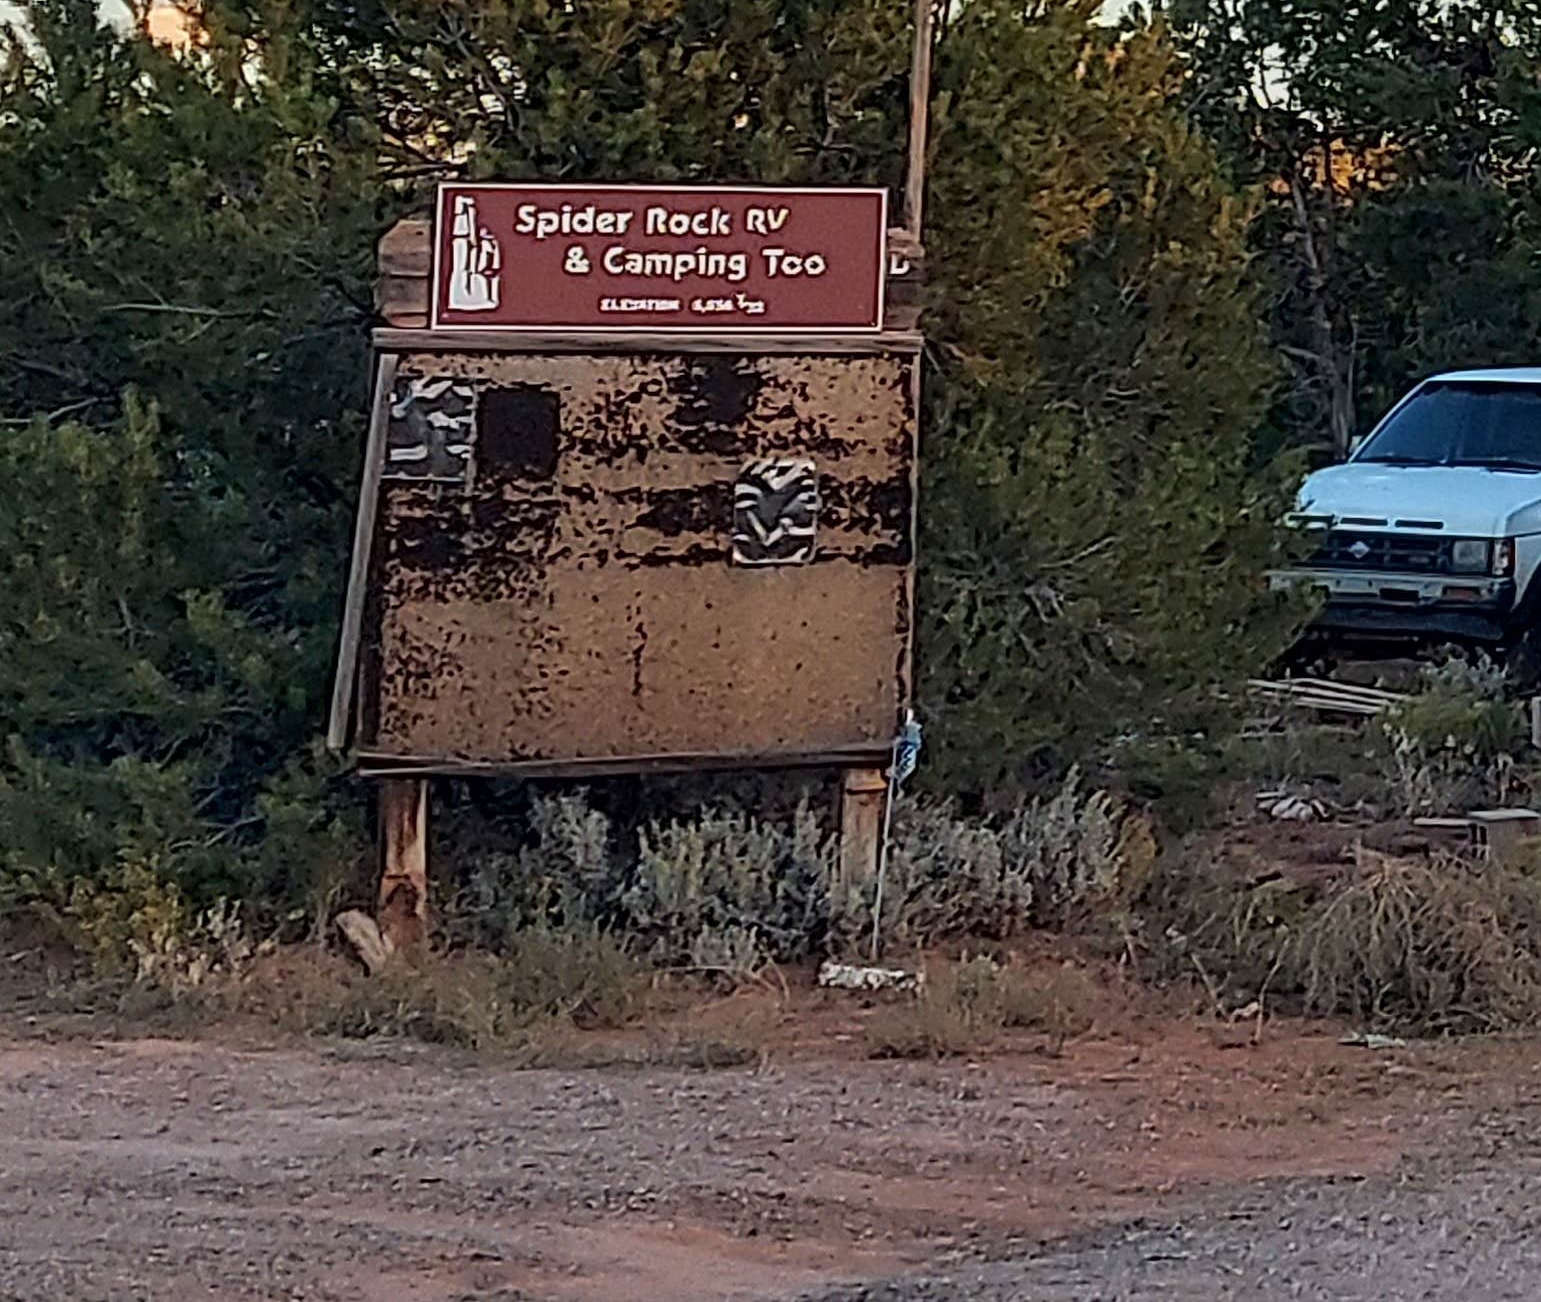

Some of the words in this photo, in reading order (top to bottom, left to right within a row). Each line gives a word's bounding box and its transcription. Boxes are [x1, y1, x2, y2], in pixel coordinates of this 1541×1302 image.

[514, 204, 634, 239] Spider
[645, 206, 732, 236] Rock
[744, 208, 790, 235] RV
[563, 245, 591, 274] &
[603, 245, 748, 282] Camping
[761, 248, 827, 278] Too
